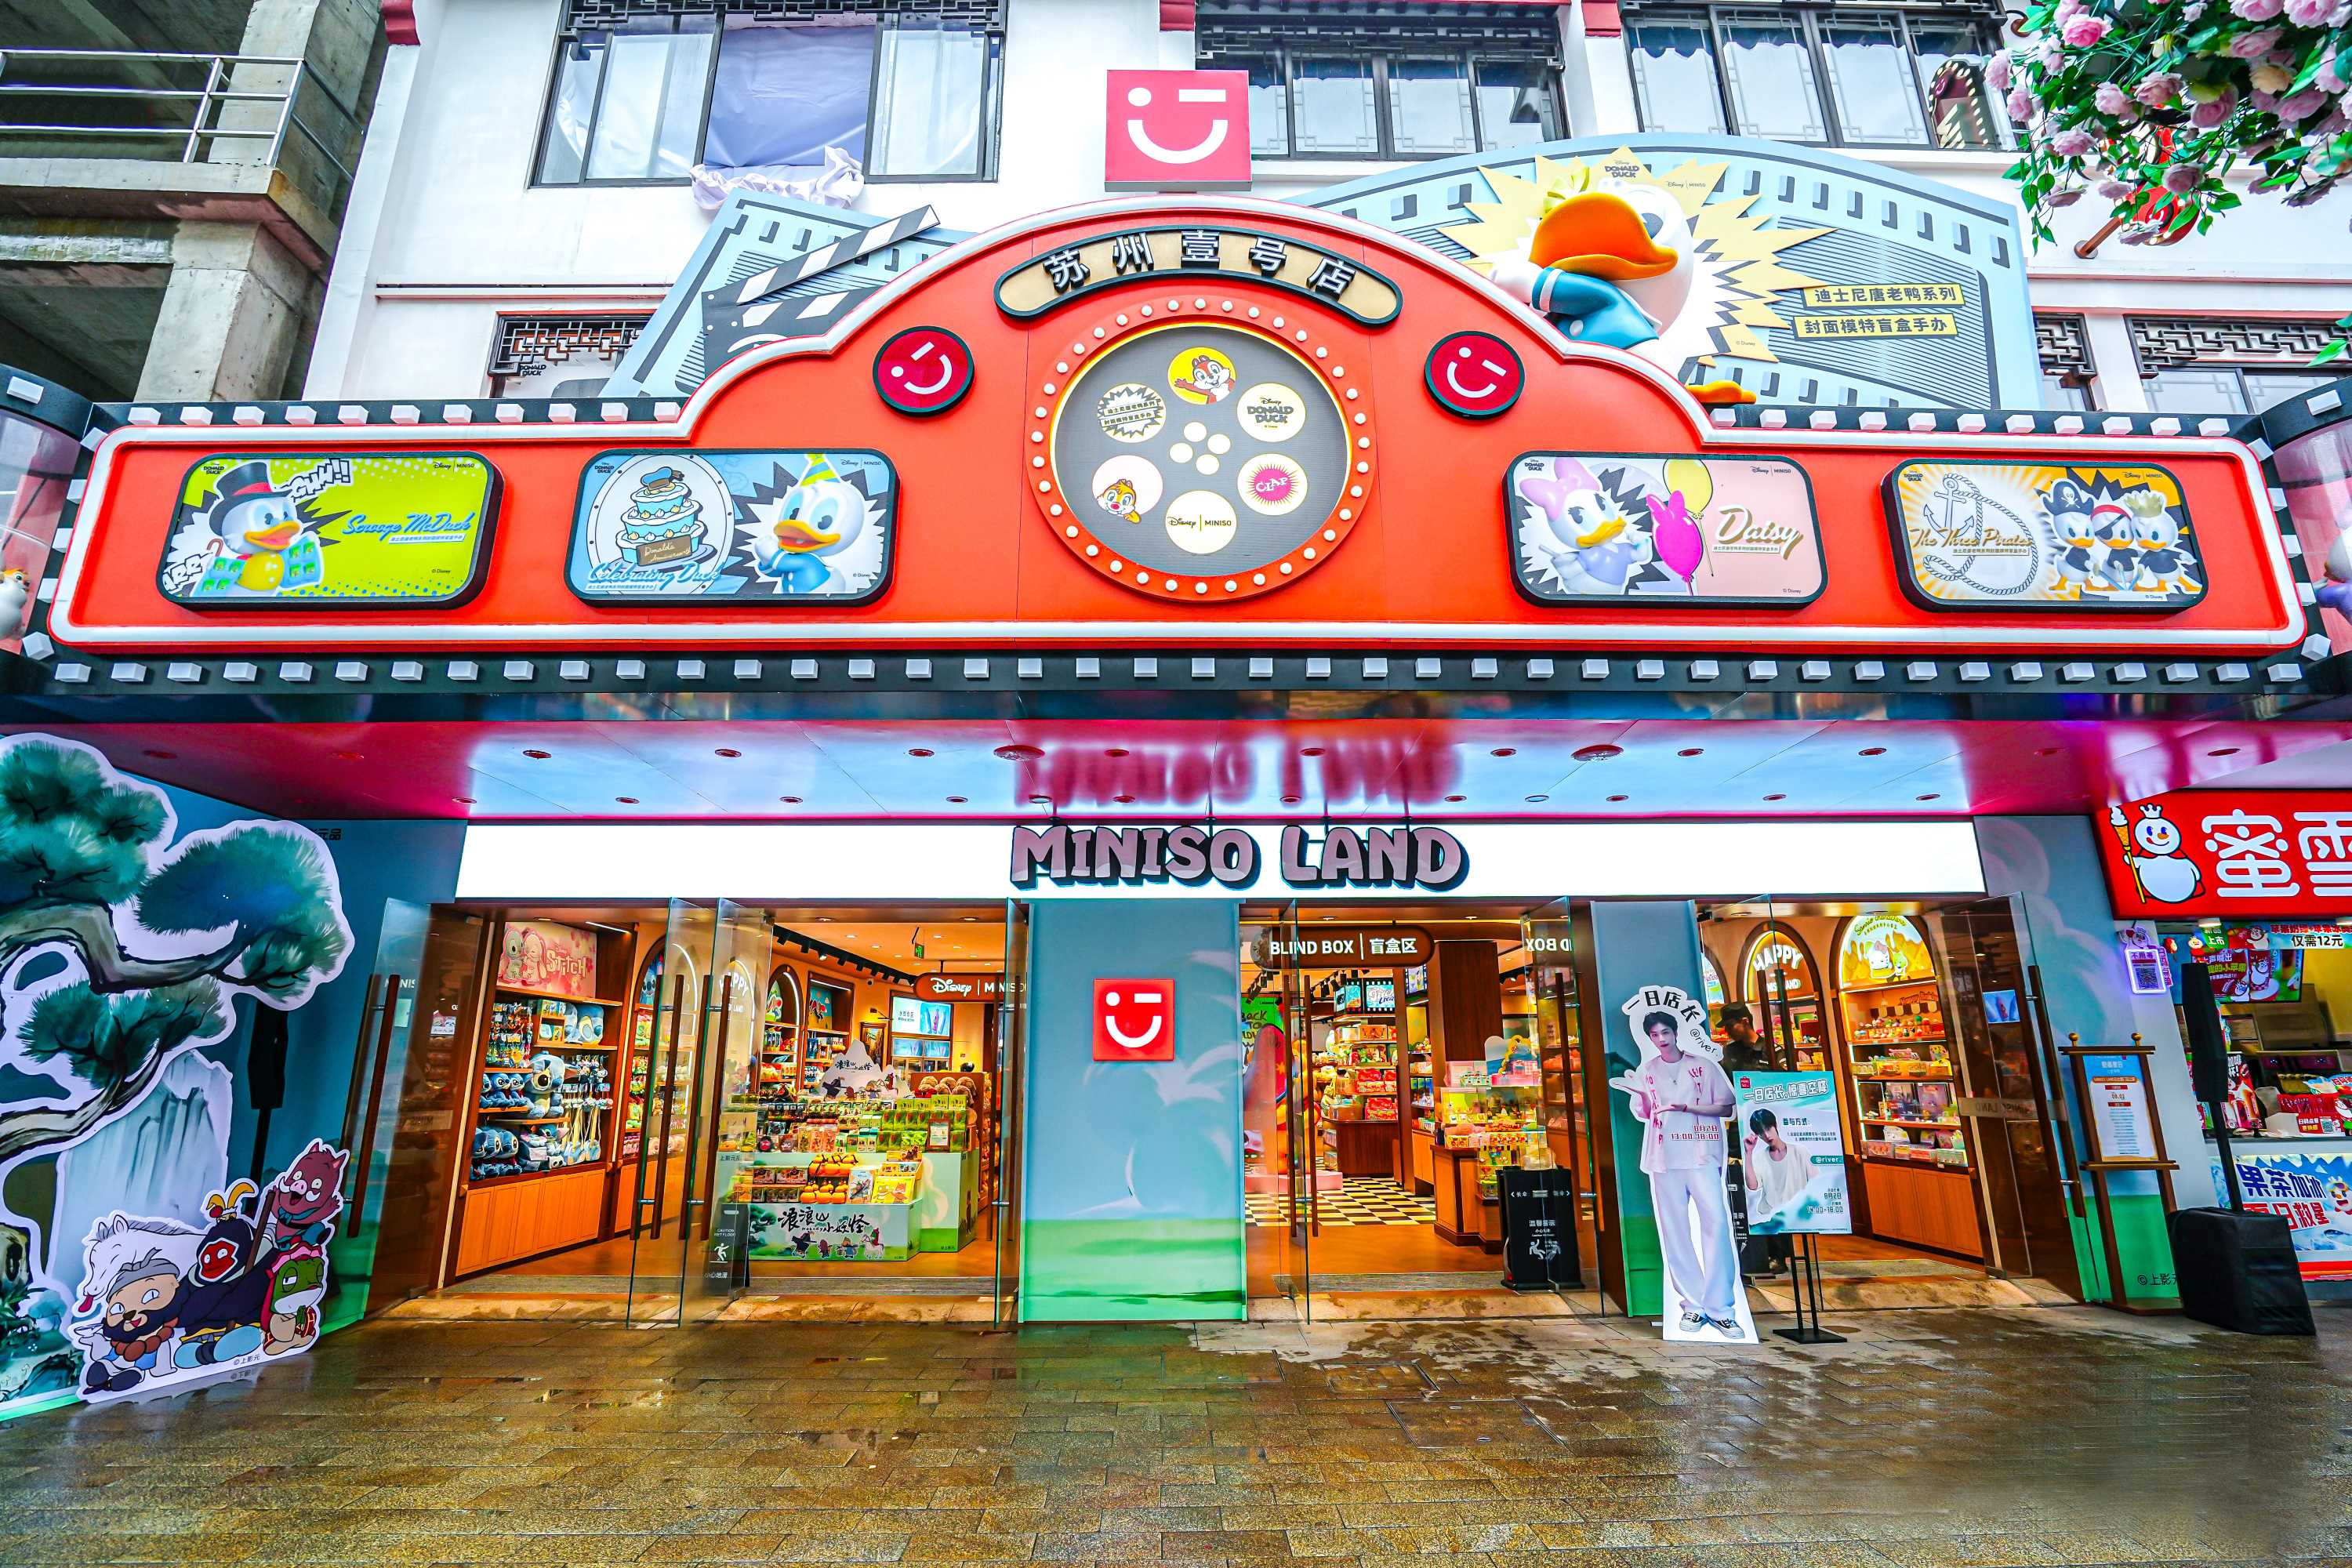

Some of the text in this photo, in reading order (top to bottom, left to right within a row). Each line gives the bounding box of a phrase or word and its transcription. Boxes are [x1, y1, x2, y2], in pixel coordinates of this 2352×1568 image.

[1044, 230, 1357, 295] 苏州壹号店
[1814, 286, 1957, 303] 迪士尼唐老鸭系列
[1804, 317, 1947, 335] 封面模特盲盒手办
[1247, 406, 1294, 415] DONALD
[1254, 414, 1287, 423] DUCK
[1255, 477, 1288, 493] CLAP
[1167, 517, 1196, 528] Disney
[1715, 504, 1804, 560] Daisy
[1909, 528, 1937, 548] The
[677, 561, 726, 583] Duck
[1011, 825, 1469, 891] MINISO LAND
[1270, 938, 1417, 954] BLIND BOX 盲盒区
[2292, 935, 2343, 947] 仅需12元
[1753, 944, 1803, 971] HAPPY
[930, 978, 972, 997] Disney
[1628, 990, 1700, 1022] 一日店长
[778, 1207, 829, 1232] 浪浪山
[823, 1214, 870, 1234] 小妖怪
[2242, 1202, 2329, 1230] 日救星
